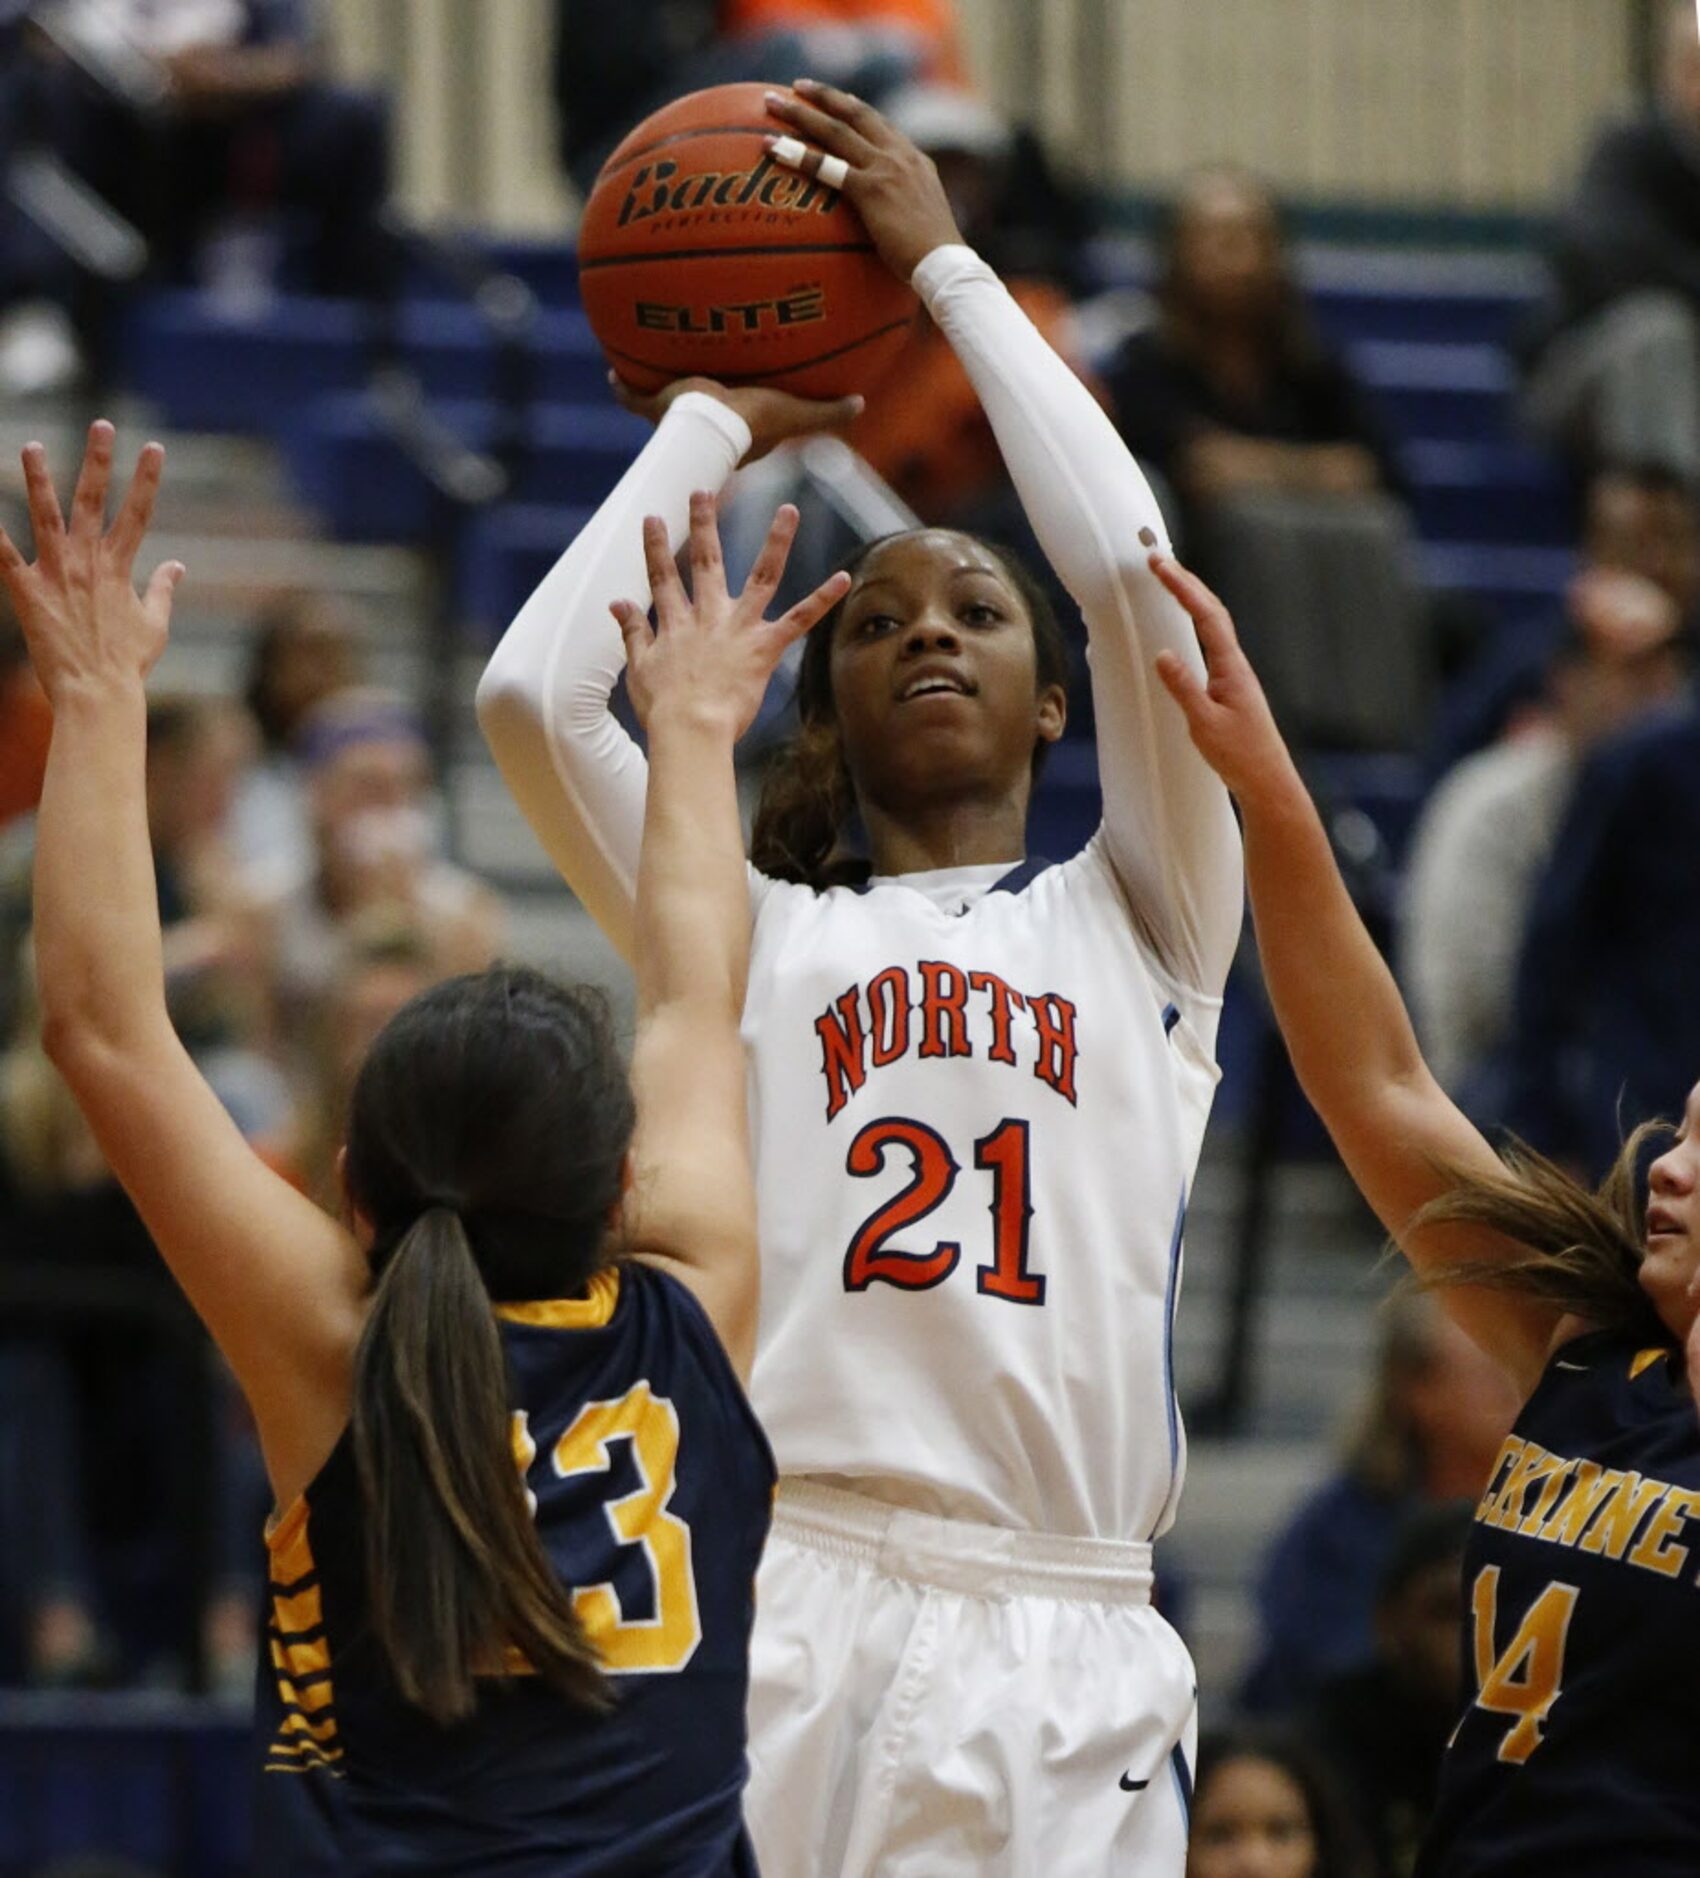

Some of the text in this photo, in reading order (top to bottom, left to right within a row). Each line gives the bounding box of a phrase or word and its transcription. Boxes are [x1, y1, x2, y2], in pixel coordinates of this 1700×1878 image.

[617, 156, 842, 228] Baden
[651, 210, 800, 233] PERFECTION
[634, 290, 826, 332] ELITE
[814, 960, 1079, 1125] NORTH
[843, 1116, 1046, 1306] 21
[1474, 1434, 1700, 1589] CKINNE
[1470, 1565, 1581, 1765] 14
